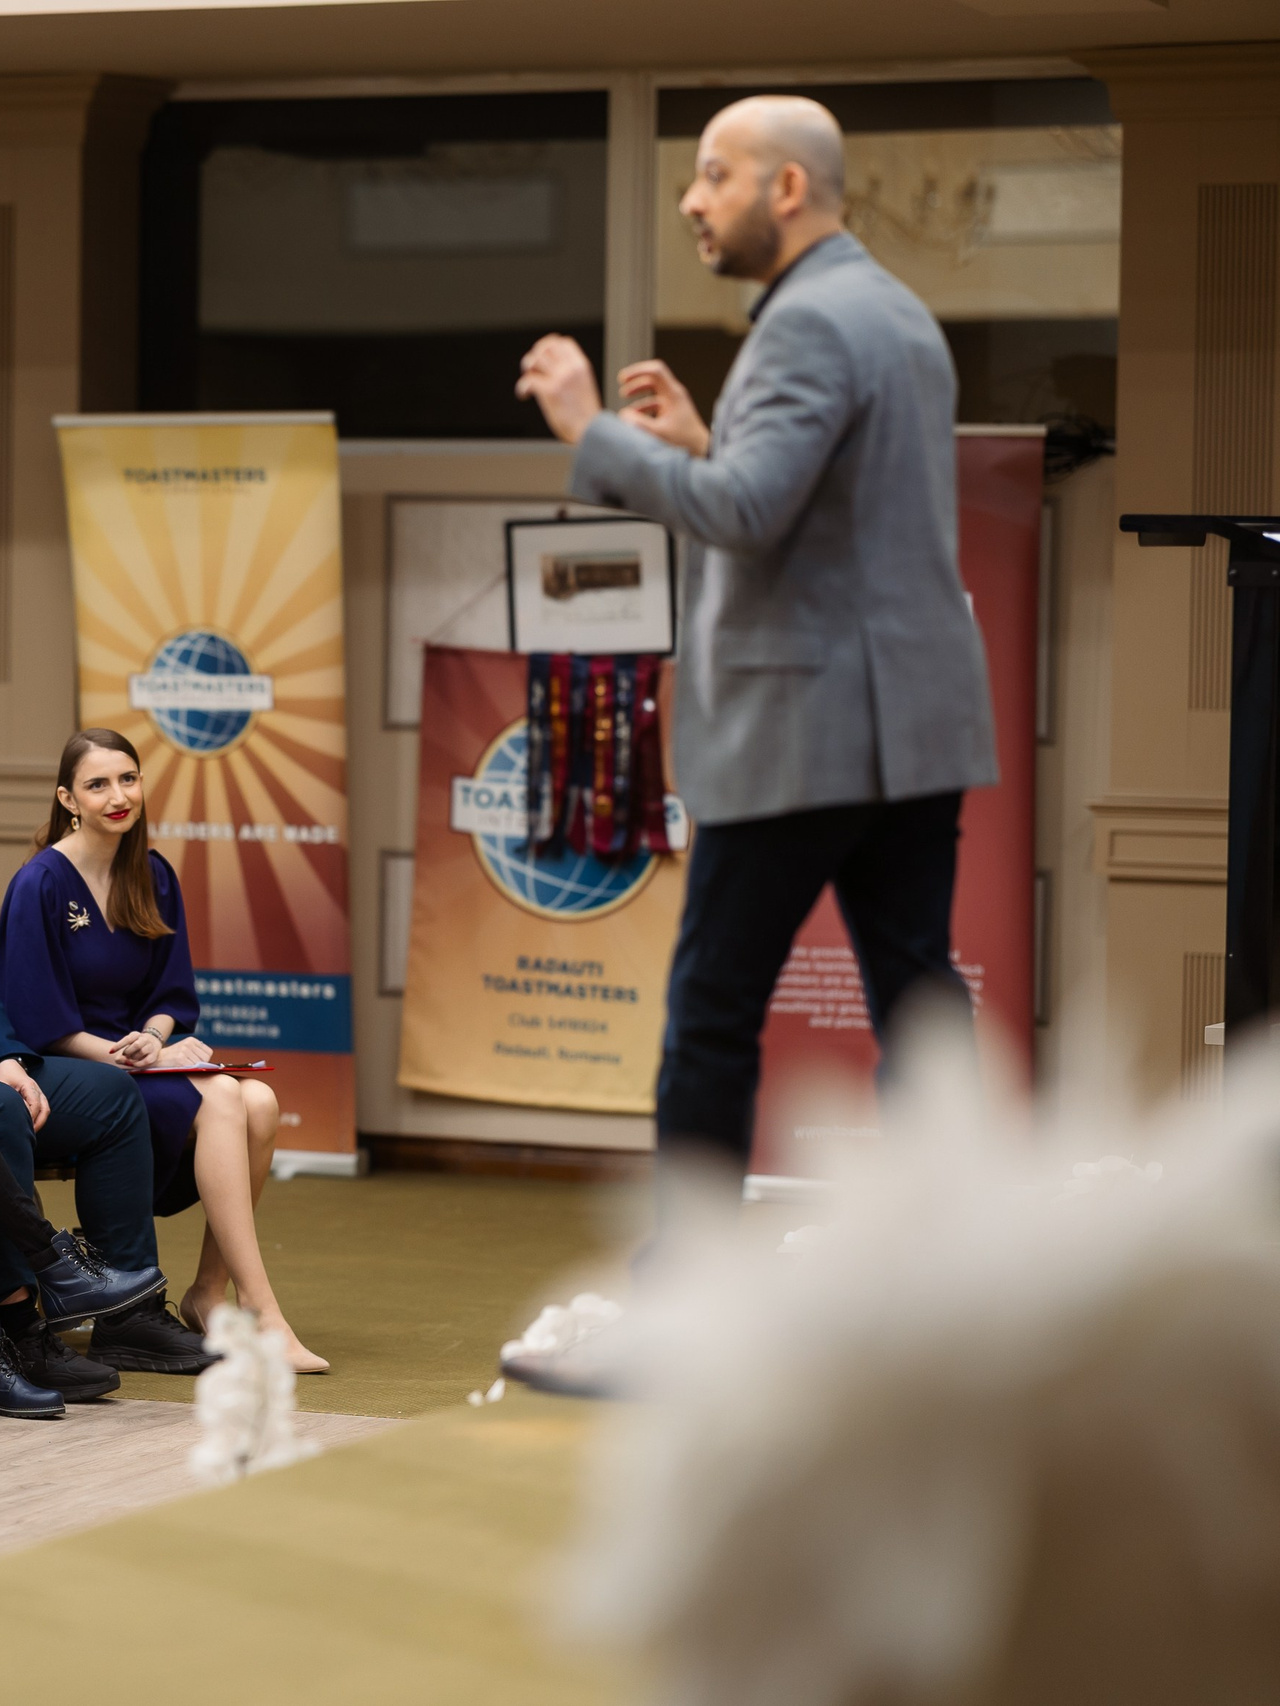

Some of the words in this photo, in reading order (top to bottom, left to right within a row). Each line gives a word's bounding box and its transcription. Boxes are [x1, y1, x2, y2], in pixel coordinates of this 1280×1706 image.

[123, 467, 267, 484] TOASTMASTERS
[137, 679, 266, 693] TOASTMASTERS
[148, 821, 236, 841] LEADERS
[238, 823, 278, 843] ARE
[283, 824, 340, 845] MADE
[194, 976, 337, 1001] oastmasters
[482, 973, 639, 1004] TOASTMASTERS
